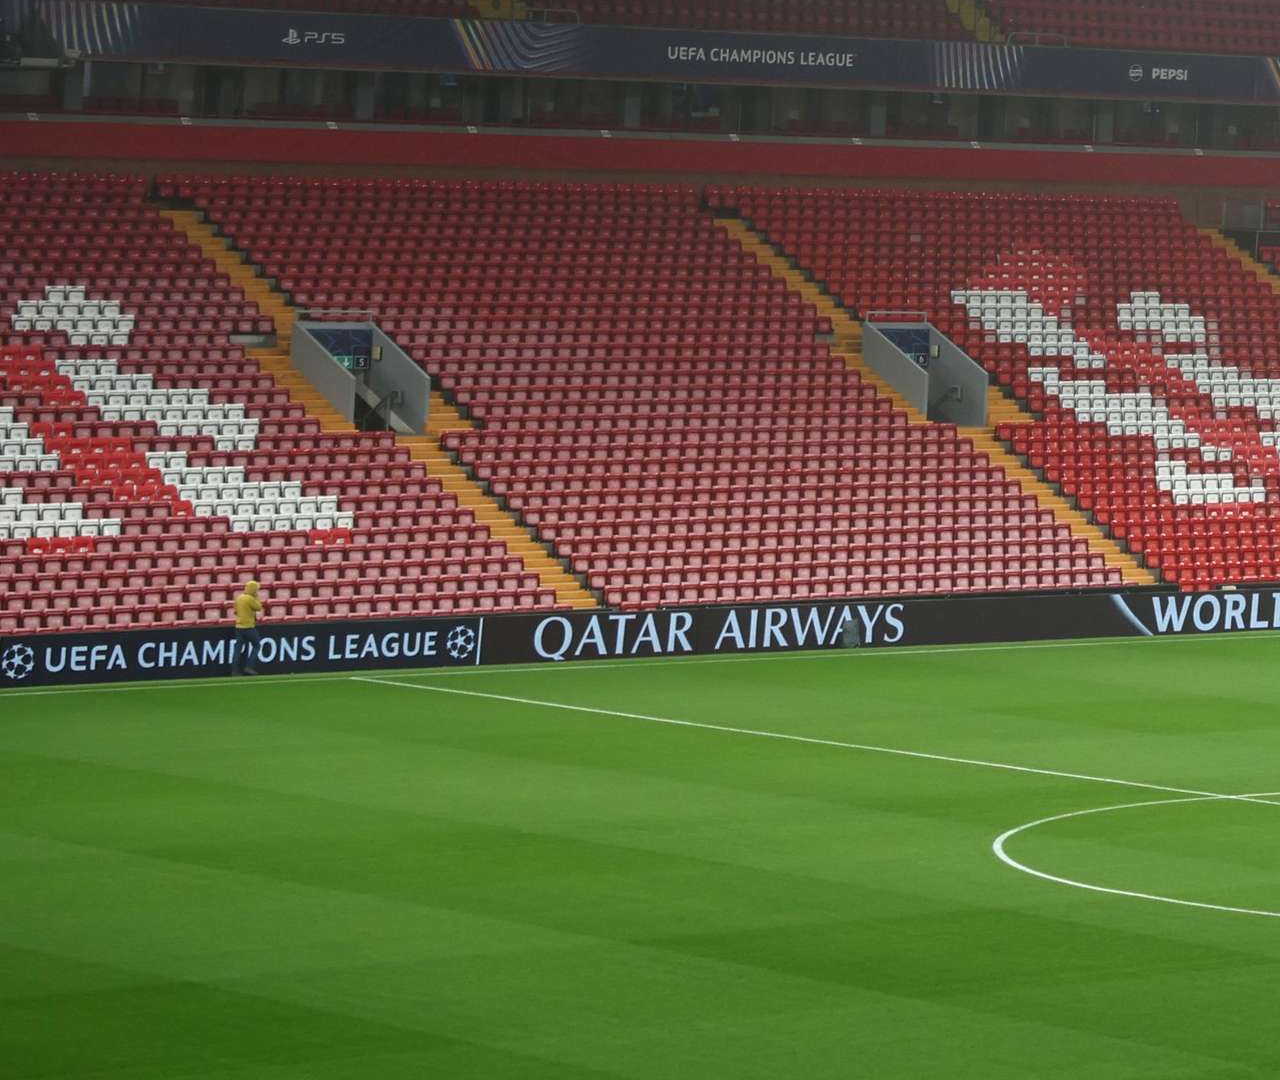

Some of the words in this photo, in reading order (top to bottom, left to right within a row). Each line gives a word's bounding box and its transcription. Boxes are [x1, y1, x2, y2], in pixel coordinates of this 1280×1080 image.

[304, 31, 345, 44] PS5
[668, 45, 706, 62] UEFA
[710, 48, 795, 65] CHAMPIONS
[800, 51, 854, 67] LEAGUE
[1152, 67, 1188, 81] PEPSI
[533, 612, 695, 661] QATAR
[715, 603, 905, 650] AIRWAYS
[45, 643, 129, 673] UEFA
[327, 630, 438, 661] LEAGUE
